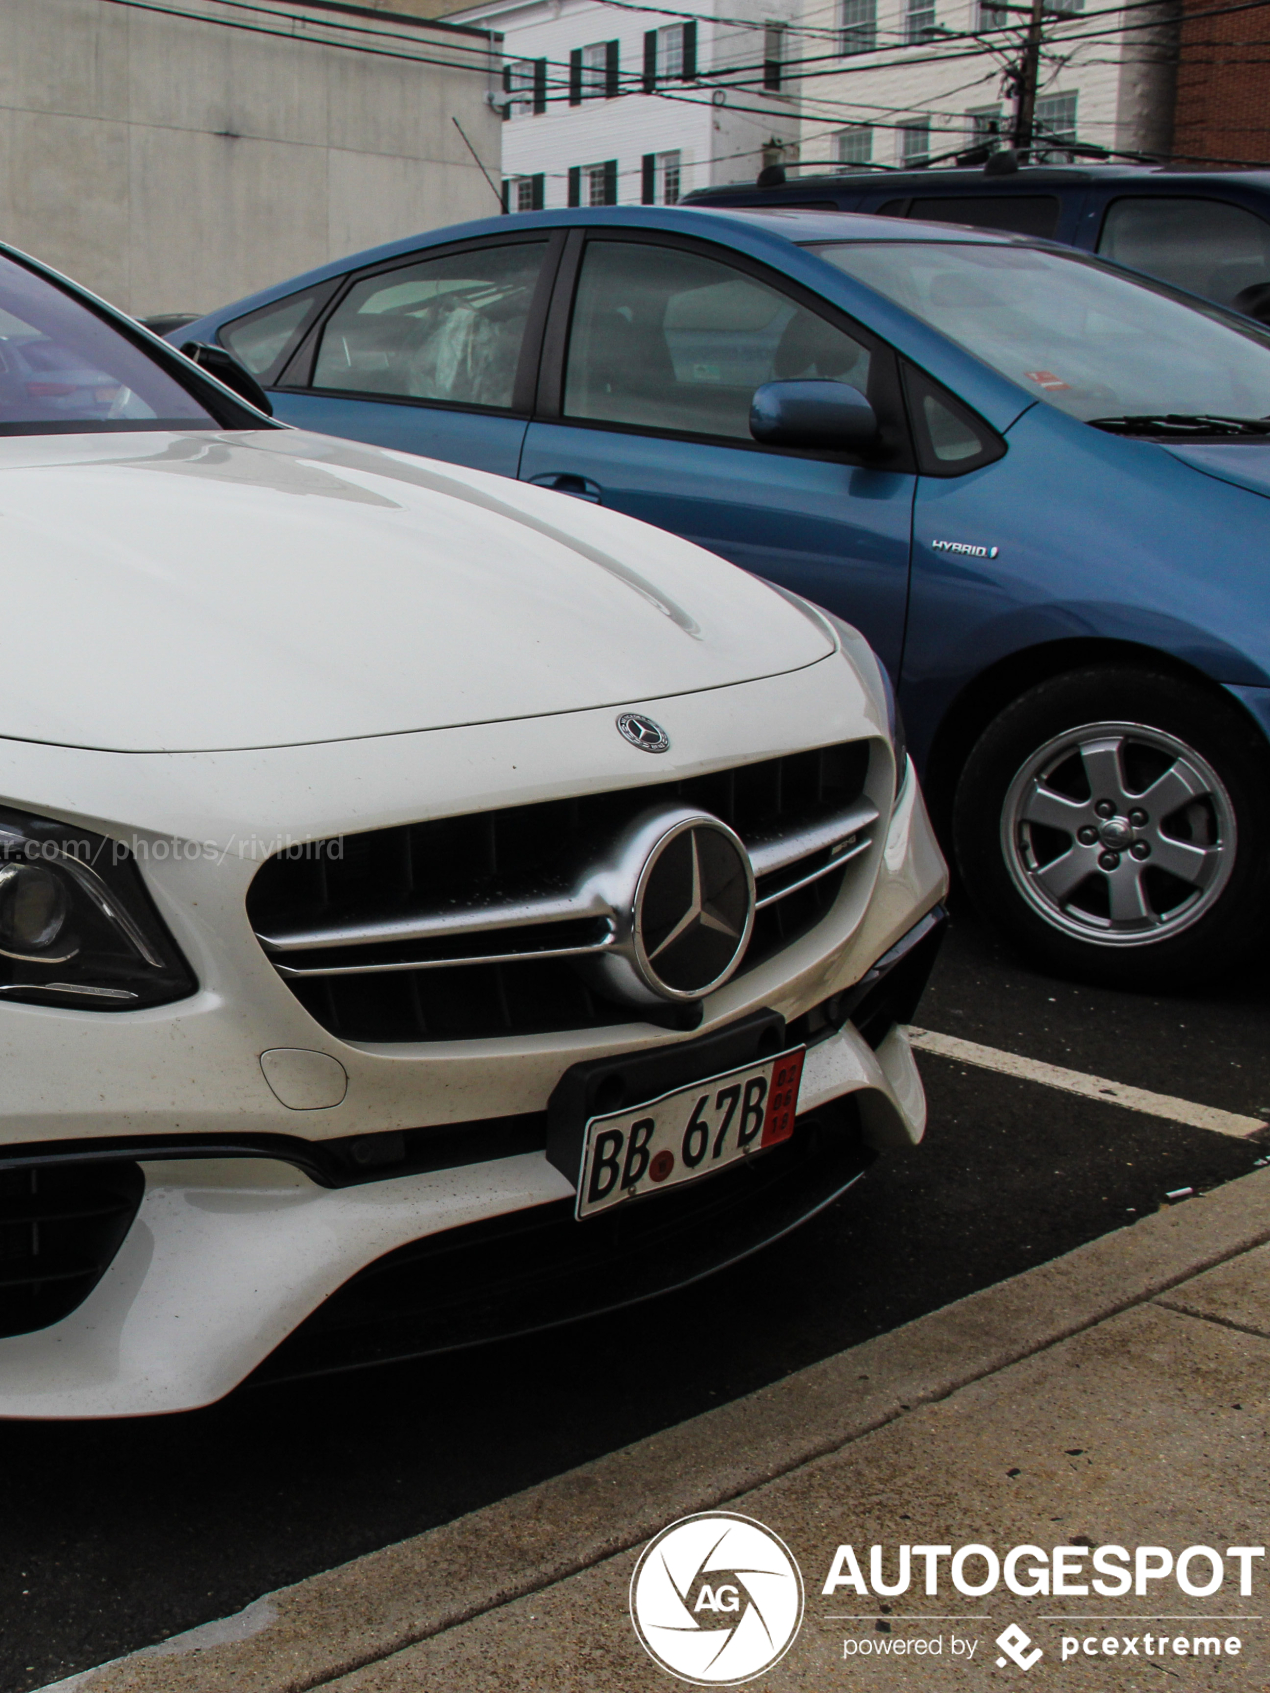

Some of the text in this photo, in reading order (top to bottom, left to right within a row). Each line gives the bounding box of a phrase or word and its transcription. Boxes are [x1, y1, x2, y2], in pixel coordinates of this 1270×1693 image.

[932, 540, 987, 556] HYBRID
[777, 1064, 797, 1087] 02
[773, 1088, 792, 1111] 06
[588, 1076, 768, 1203] BB 67B
